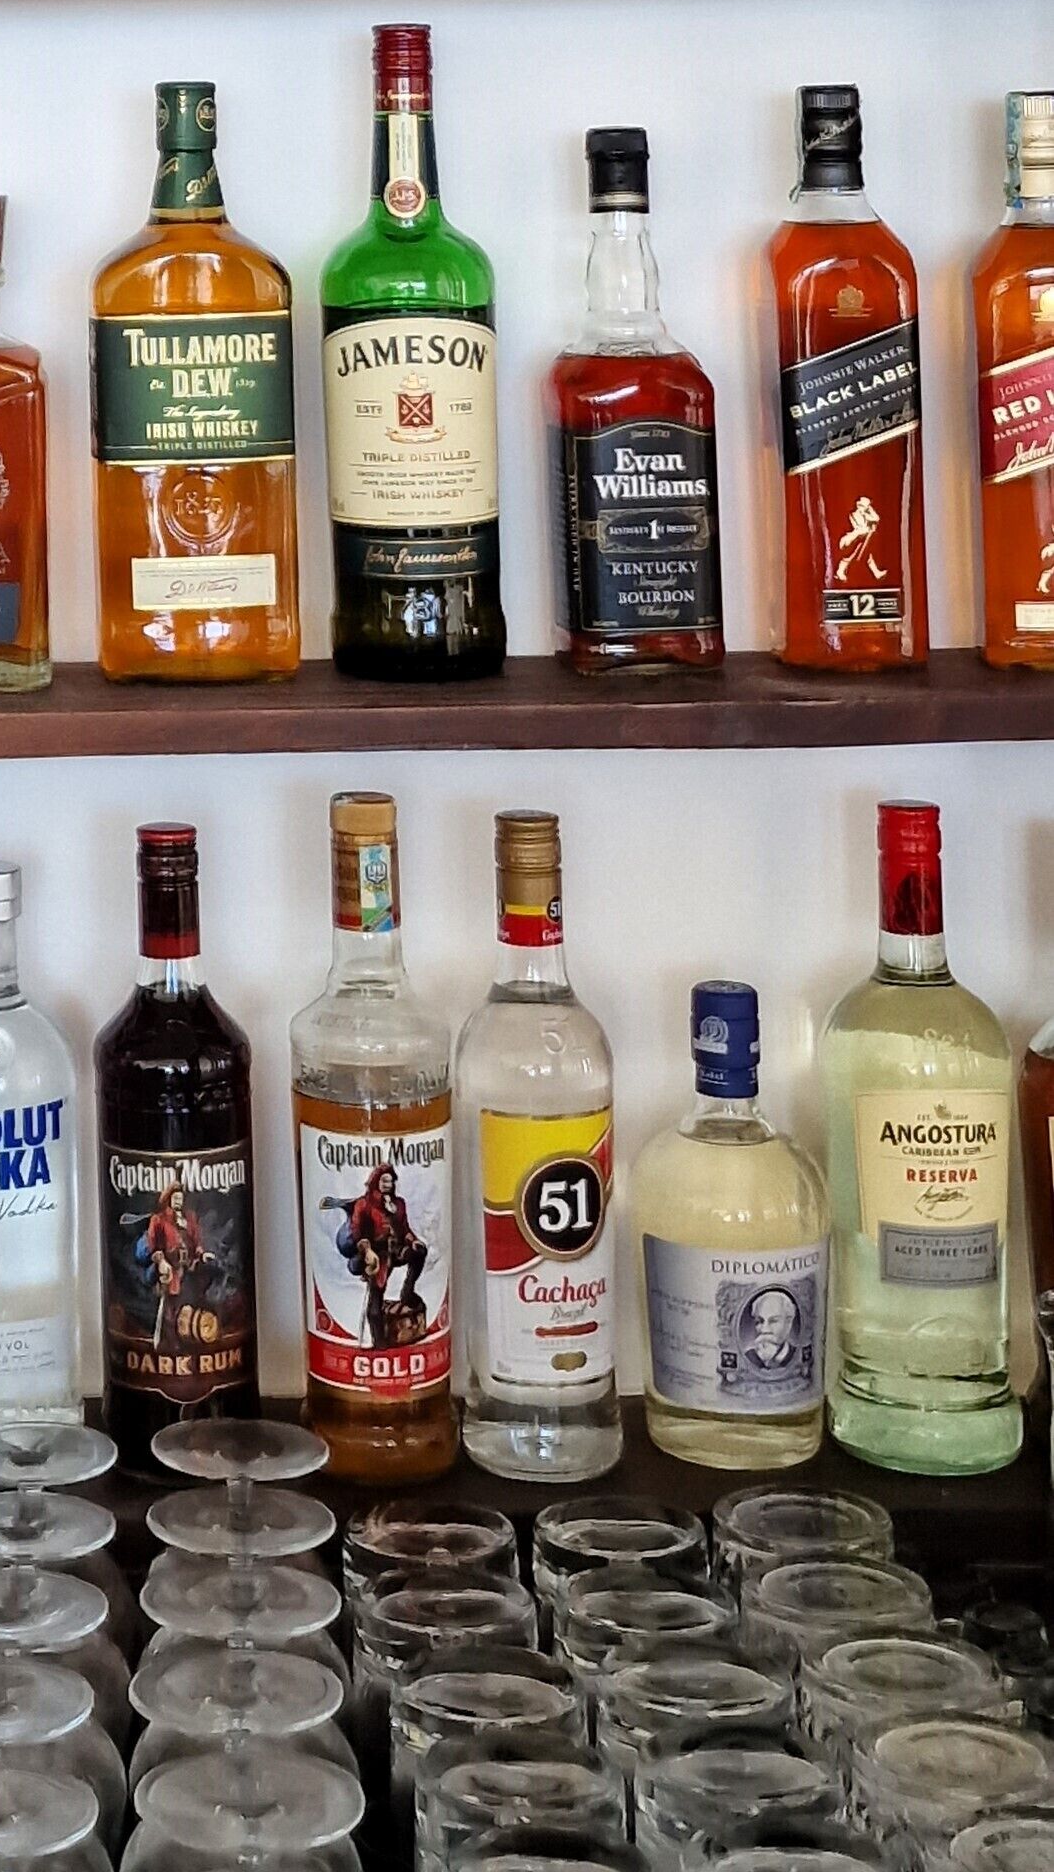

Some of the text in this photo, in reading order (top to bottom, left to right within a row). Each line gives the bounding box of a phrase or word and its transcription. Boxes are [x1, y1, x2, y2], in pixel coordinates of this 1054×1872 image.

[122, 329, 277, 367] TULLAMORE
[337, 334, 487, 377] JAMESON
[799, 344, 910, 394] JOHNNIE WALKER
[789, 361, 919, 419] BLACK LABEL
[992, 395, 1042, 426] RED
[146, 420, 259, 439] IRISH WHISKEY
[158, 441, 247, 451] TRIPLE DISTILLED
[362, 450, 471, 463] TRIPLE DISTILLED
[613, 448, 686, 474] Evan
[373, 489, 465, 500] IRISH WHISKEY
[592, 474, 708, 500] Williams
[609, 561, 700, 576] KENTUCKY
[618, 590, 695, 605] BOURBON
[848, 593, 876, 618] 12
[879, 1121, 997, 1146] ANGOSTURA
[317, 1134, 446, 1174] Captain Morgan
[901, 1145, 959, 1157] CARIBBEAN
[109, 1154, 246, 1197] Captain Morgan
[906, 1167, 978, 1184] RESERVA
[538, 1177, 593, 1234] 51
[895, 1246, 921, 1256] AGED
[926, 1246, 957, 1257] THREE
[517, 1273, 607, 1309] Cachaça
[127, 1347, 243, 1377] DARK RUM
[352, 1353, 425, 1380] GOLD
